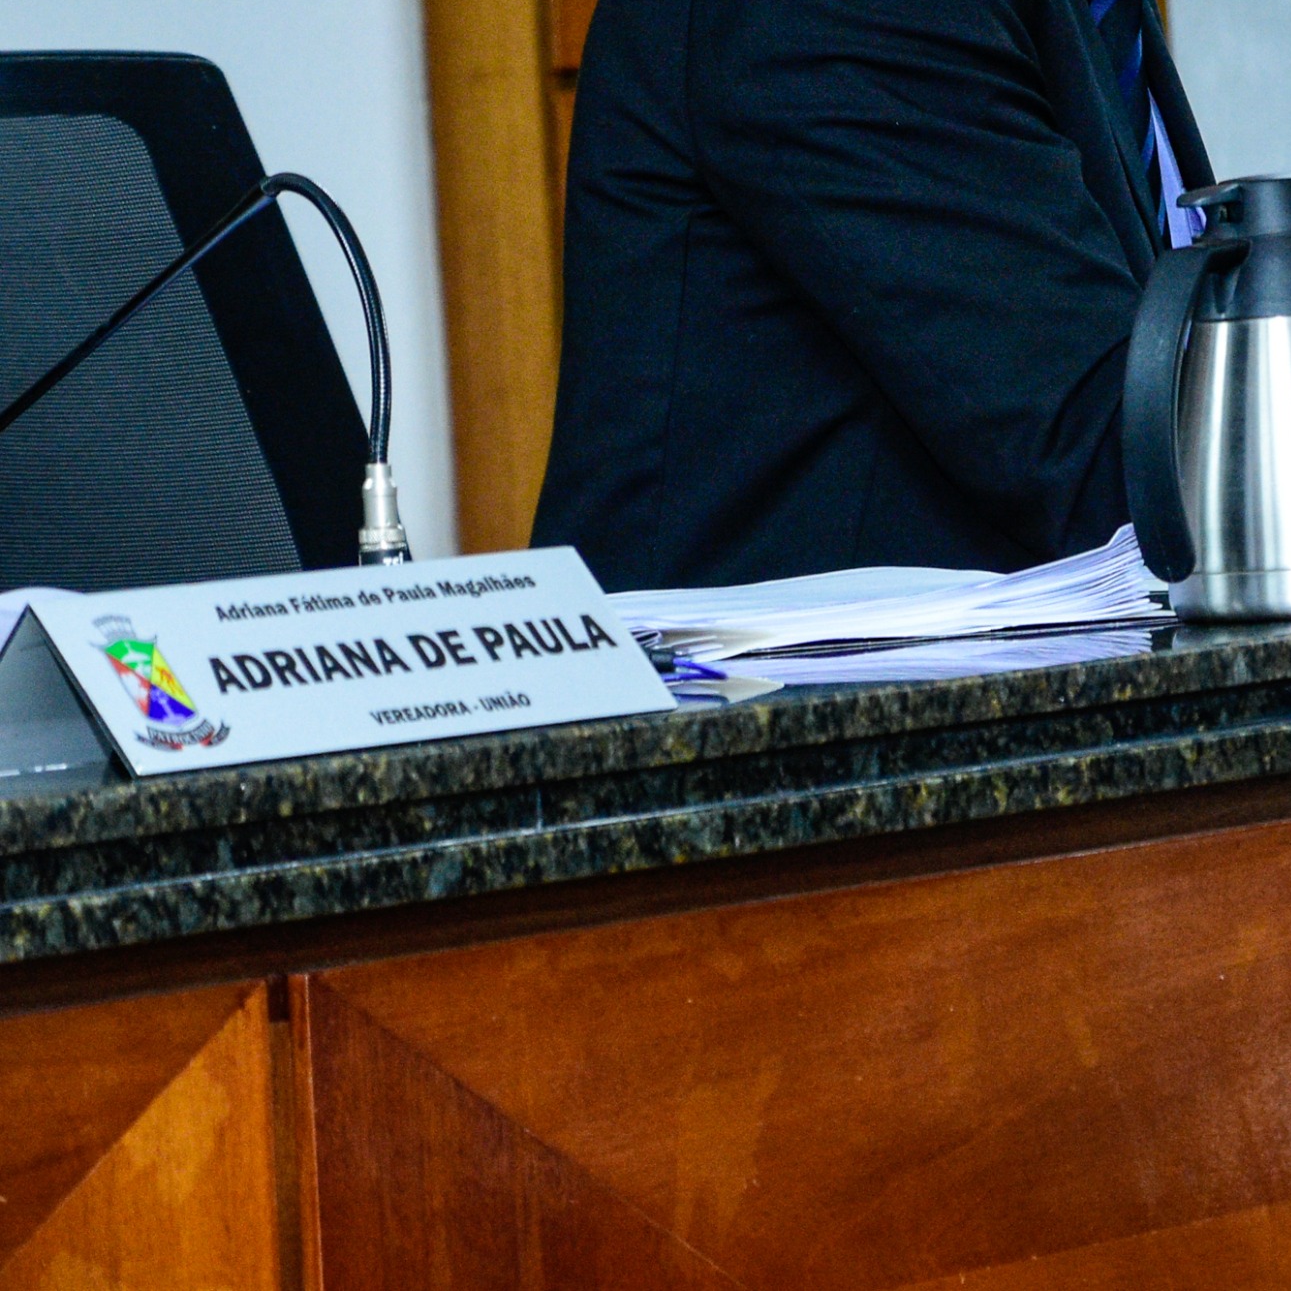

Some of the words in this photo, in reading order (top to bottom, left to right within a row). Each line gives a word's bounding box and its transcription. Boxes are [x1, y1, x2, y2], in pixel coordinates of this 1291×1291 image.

[215, 601, 289, 622] Adriana
[288, 594, 355, 613] Fátima
[357, 589, 382, 606] de
[382, 584, 437, 603] Paula
[436, 575, 537, 598] Magalhães
[209, 639, 412, 694] ADRIANA
[406, 630, 477, 669] DE
[472, 614, 618, 661] PAULA
[370, 699, 472, 725] VEREADORA
[479, 691, 532, 712] UNIÃO
